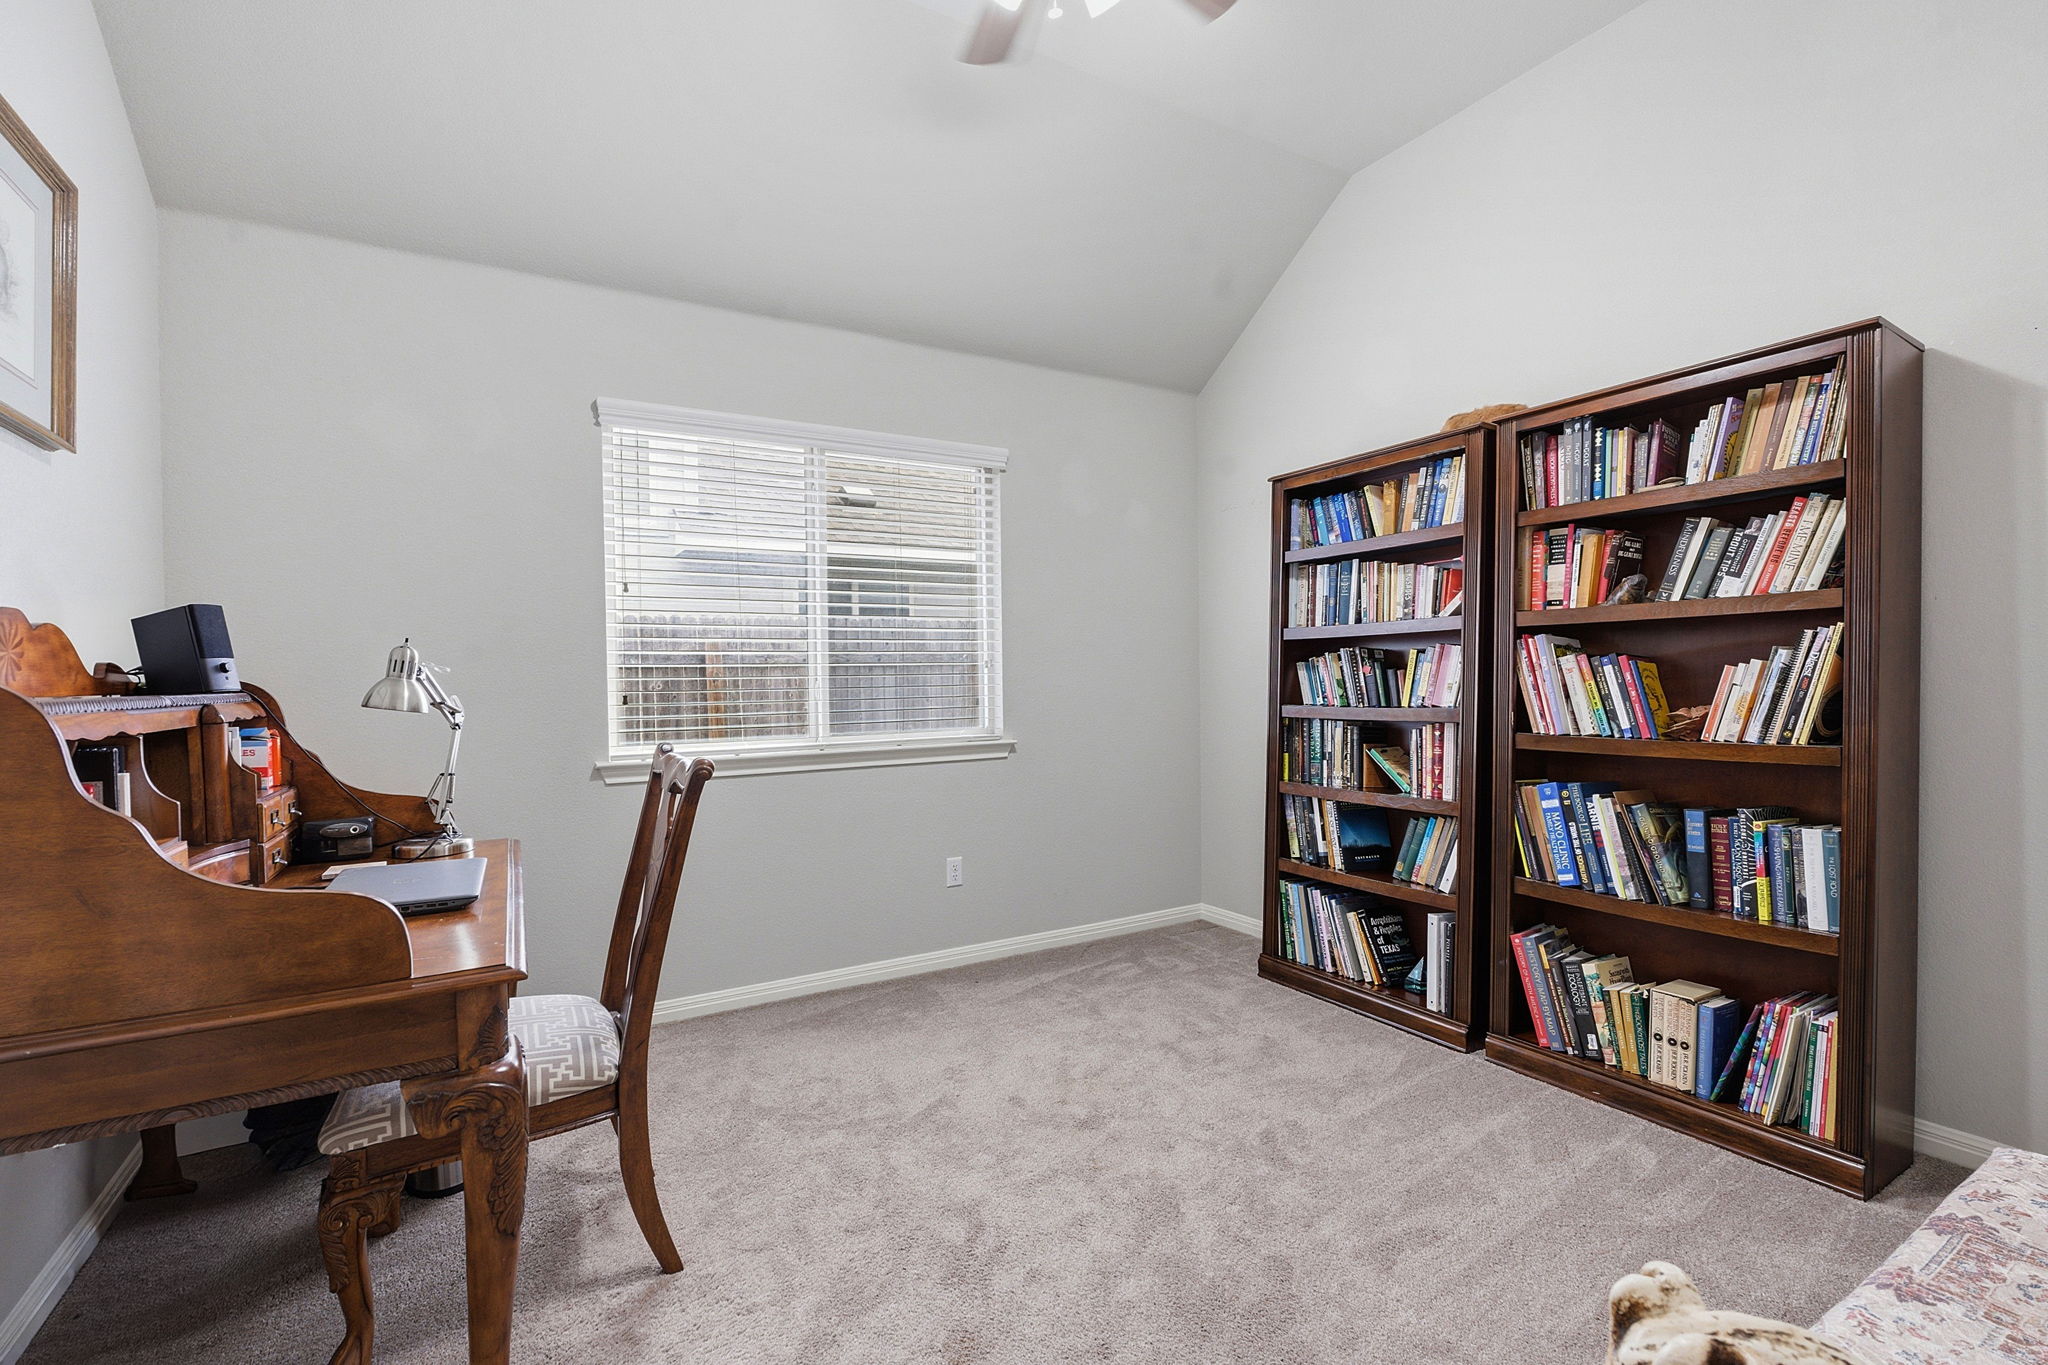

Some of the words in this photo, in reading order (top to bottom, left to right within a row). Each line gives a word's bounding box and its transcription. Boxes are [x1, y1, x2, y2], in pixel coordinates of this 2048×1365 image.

[1786, 501, 1803, 528] BEASTS
[1668, 523, 1694, 576] MINDFULNESS
[1726, 531, 1743, 557] TROUT
[1776, 528, 1791, 554] BEFORE
[1717, 558, 1731, 578] TIPS
[1771, 553, 1780, 564] US
[1784, 541, 1804, 571] MINE
[1803, 649, 1820, 677] Digest
[1551, 812, 1564, 838] MAYO
[1586, 801, 1601, 830] ARNIE
[1579, 822, 1592, 845] LIFE
[1557, 840, 1570, 870] CLINIC
[1829, 880, 1837, 897] ROAD
[1373, 927, 1379, 935] &
[1377, 935, 1385, 944] of
[1379, 944, 1400, 954] TEXAS
[1528, 950, 1542, 984] HISTORY
[1537, 987, 1547, 1005] MAP
[1567, 973, 1581, 1007] ZOOLOGY
[1543, 1006, 1551, 1018] BY
[1545, 1017, 1556, 1036] MAP
